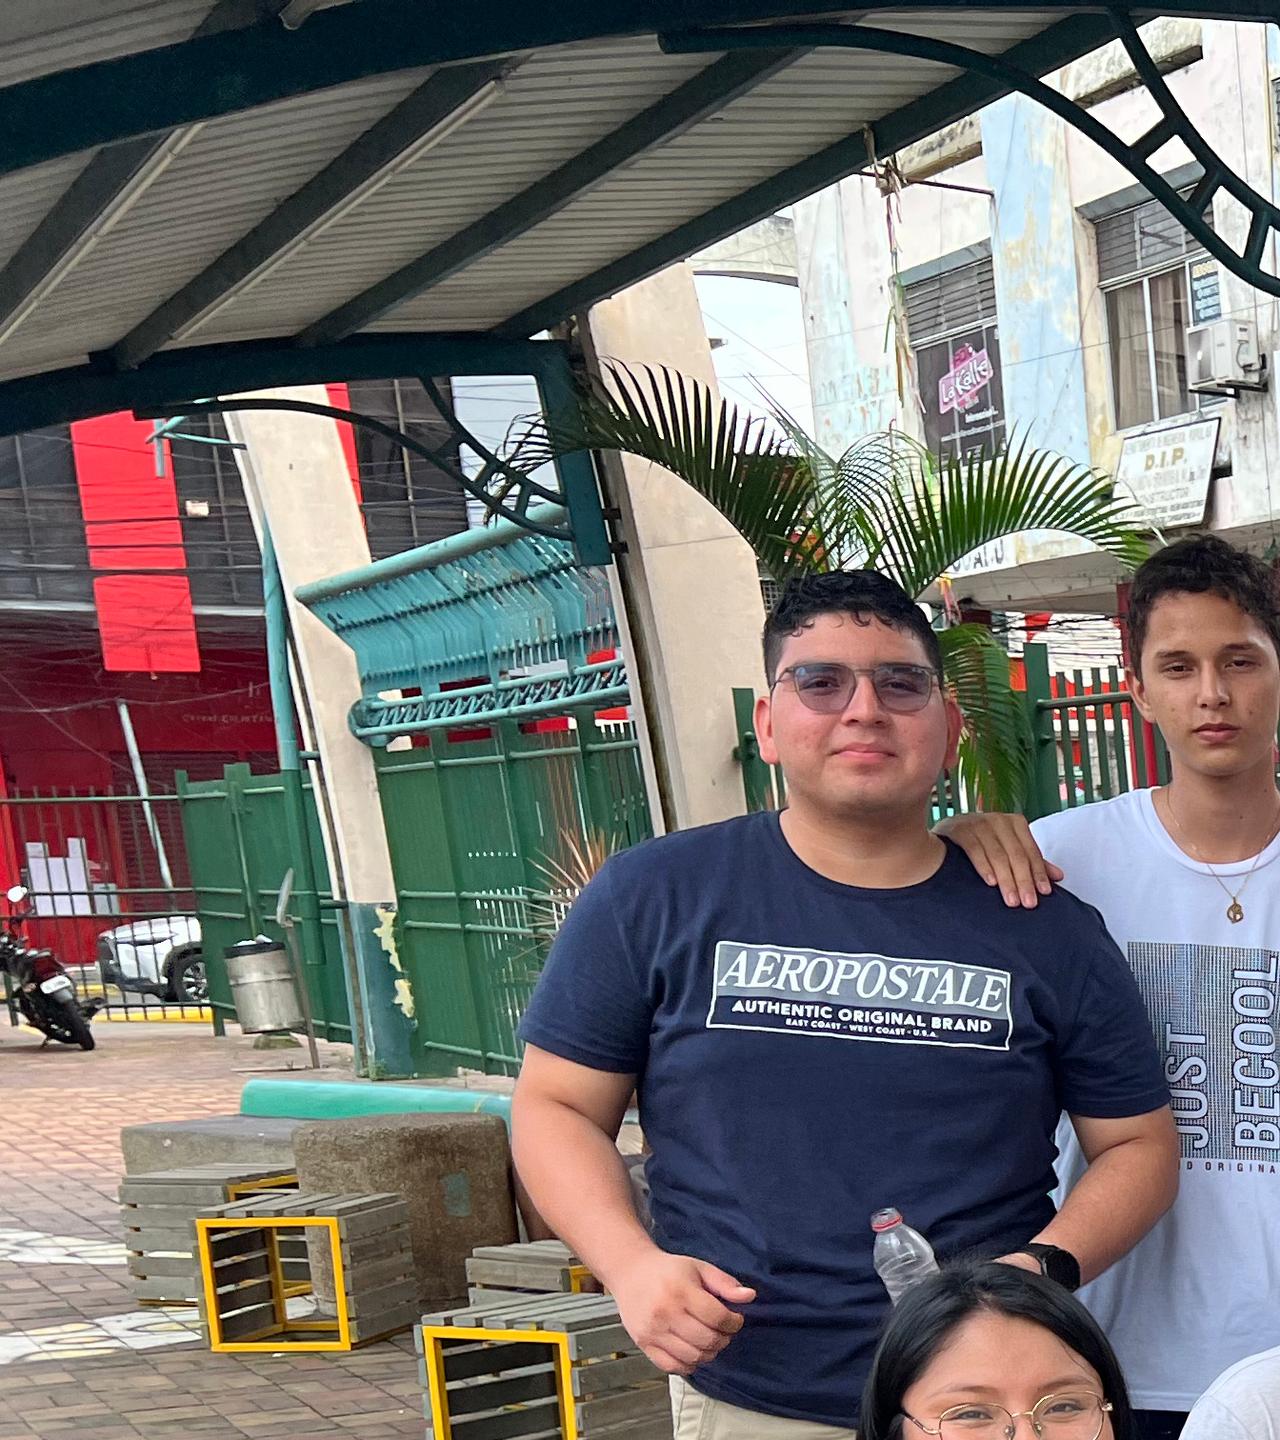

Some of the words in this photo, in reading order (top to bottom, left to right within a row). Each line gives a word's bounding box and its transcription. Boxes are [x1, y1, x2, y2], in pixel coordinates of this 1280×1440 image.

[955, 359, 988, 396] Kalle
[1144, 447, 1187, 471] D.I.P.
[718, 950, 1008, 1012] AEROPOSTALE
[732, 999, 833, 1021] AUTHENTIC
[838, 1007, 926, 1028] ORIGINAL
[931, 1016, 992, 1033] BRAND
[786, 1018, 809, 1027] EAST
[811, 1021, 841, 1030] COAST
[849, 1024, 873, 1033] WEST
[875, 1027, 906, 1036] COAST
[1232, 955, 1280, 1150] BECOOL
[1165, 1023, 1210, 1150] JUST
